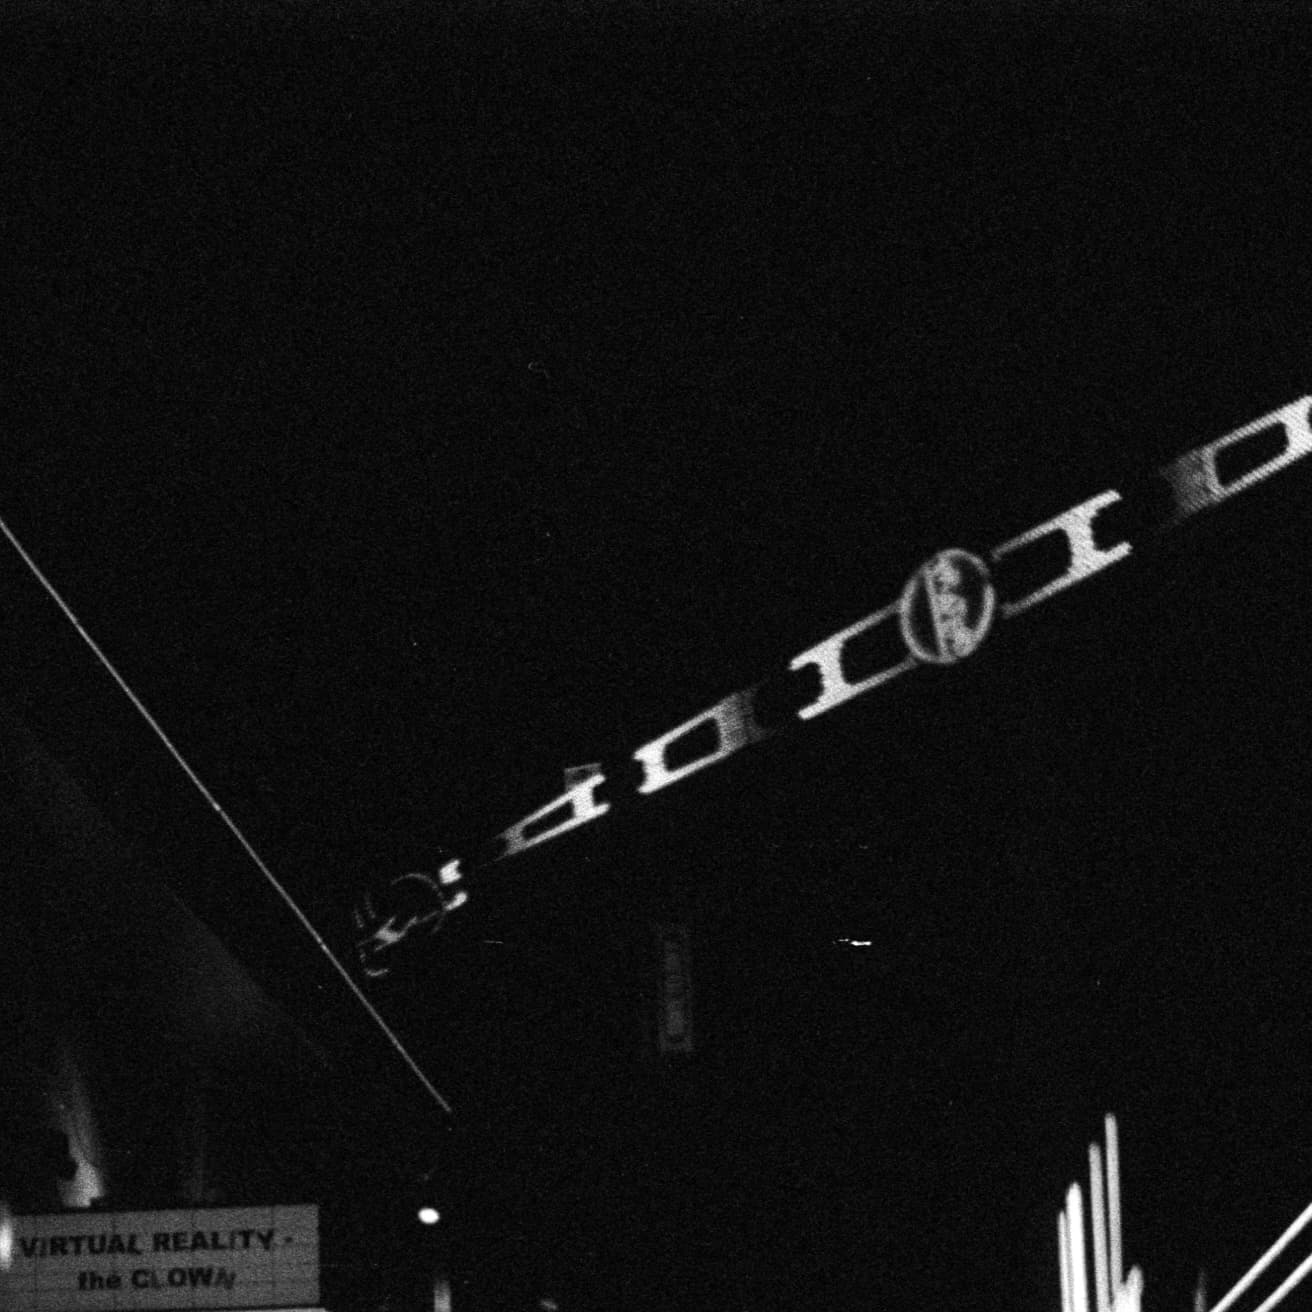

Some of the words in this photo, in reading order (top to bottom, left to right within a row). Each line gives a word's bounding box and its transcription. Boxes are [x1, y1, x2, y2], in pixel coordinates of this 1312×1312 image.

[19, 1234, 142, 1257] VIRTUAL
[152, 1228, 274, 1251] REALITY
[78, 1270, 122, 1290] the
[131, 1266, 237, 1290] CLOWN
